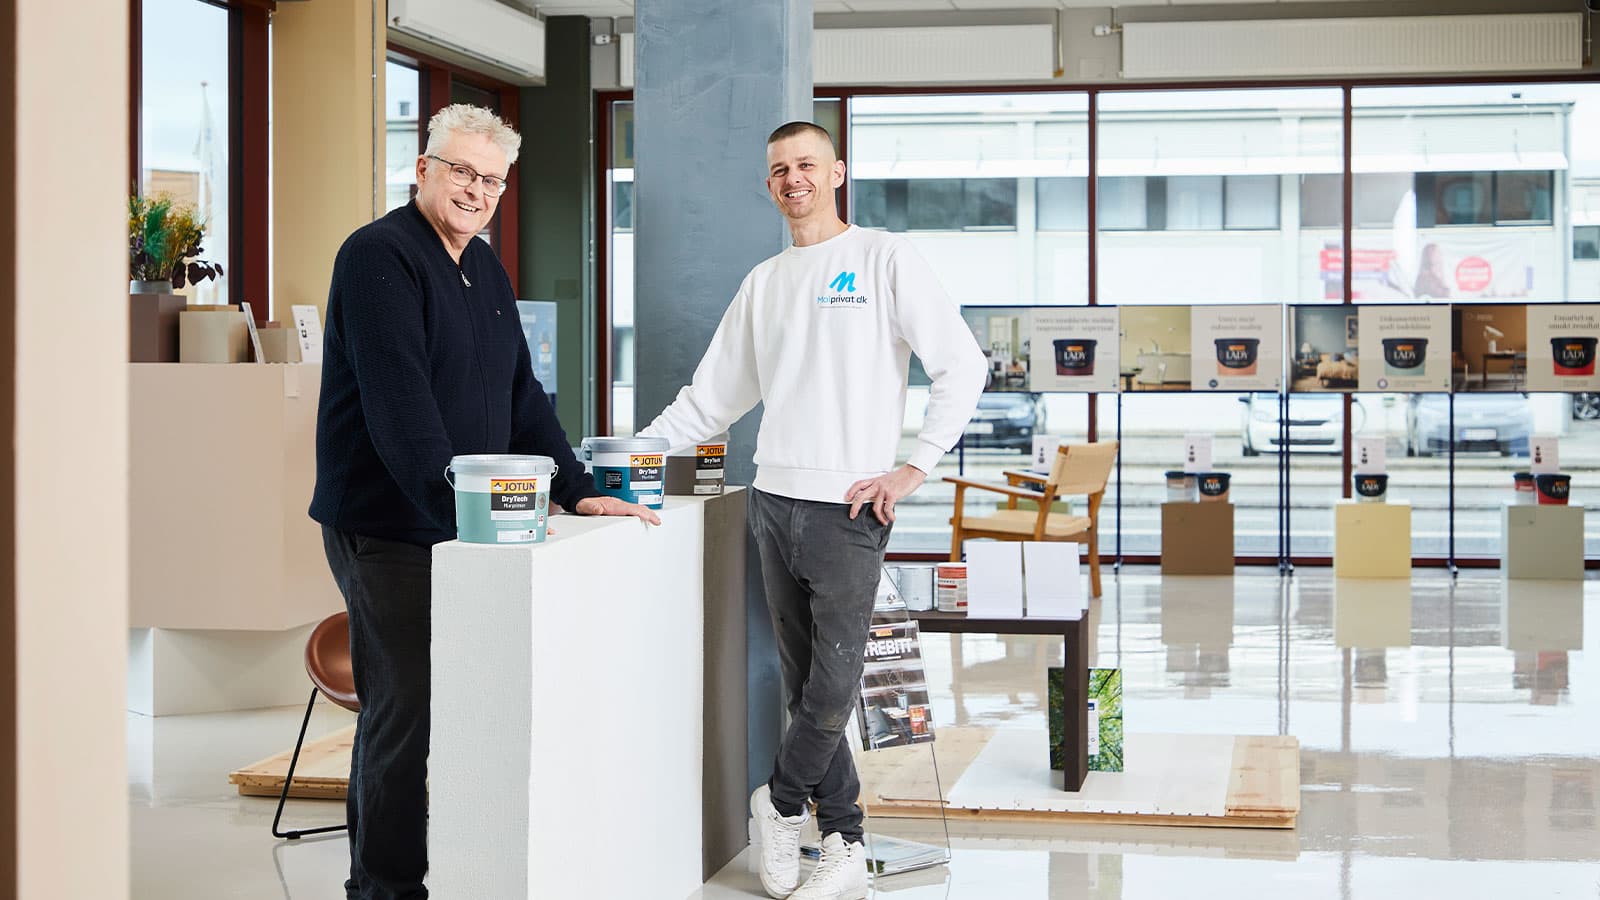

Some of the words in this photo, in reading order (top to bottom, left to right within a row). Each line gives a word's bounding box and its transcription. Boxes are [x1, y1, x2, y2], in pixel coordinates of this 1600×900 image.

[818, 295, 867, 304] Malprivatdk
[1063, 351, 1087, 361] LADY
[1226, 350, 1249, 360] LADY
[1393, 350, 1416, 360] LADY
[1562, 350, 1585, 360] LADY
[641, 457, 662, 466] JOTUN
[504, 482, 536, 492] JOTUN
[501, 495, 528, 504] DryTech
[863, 638, 913, 657] TREBITT
